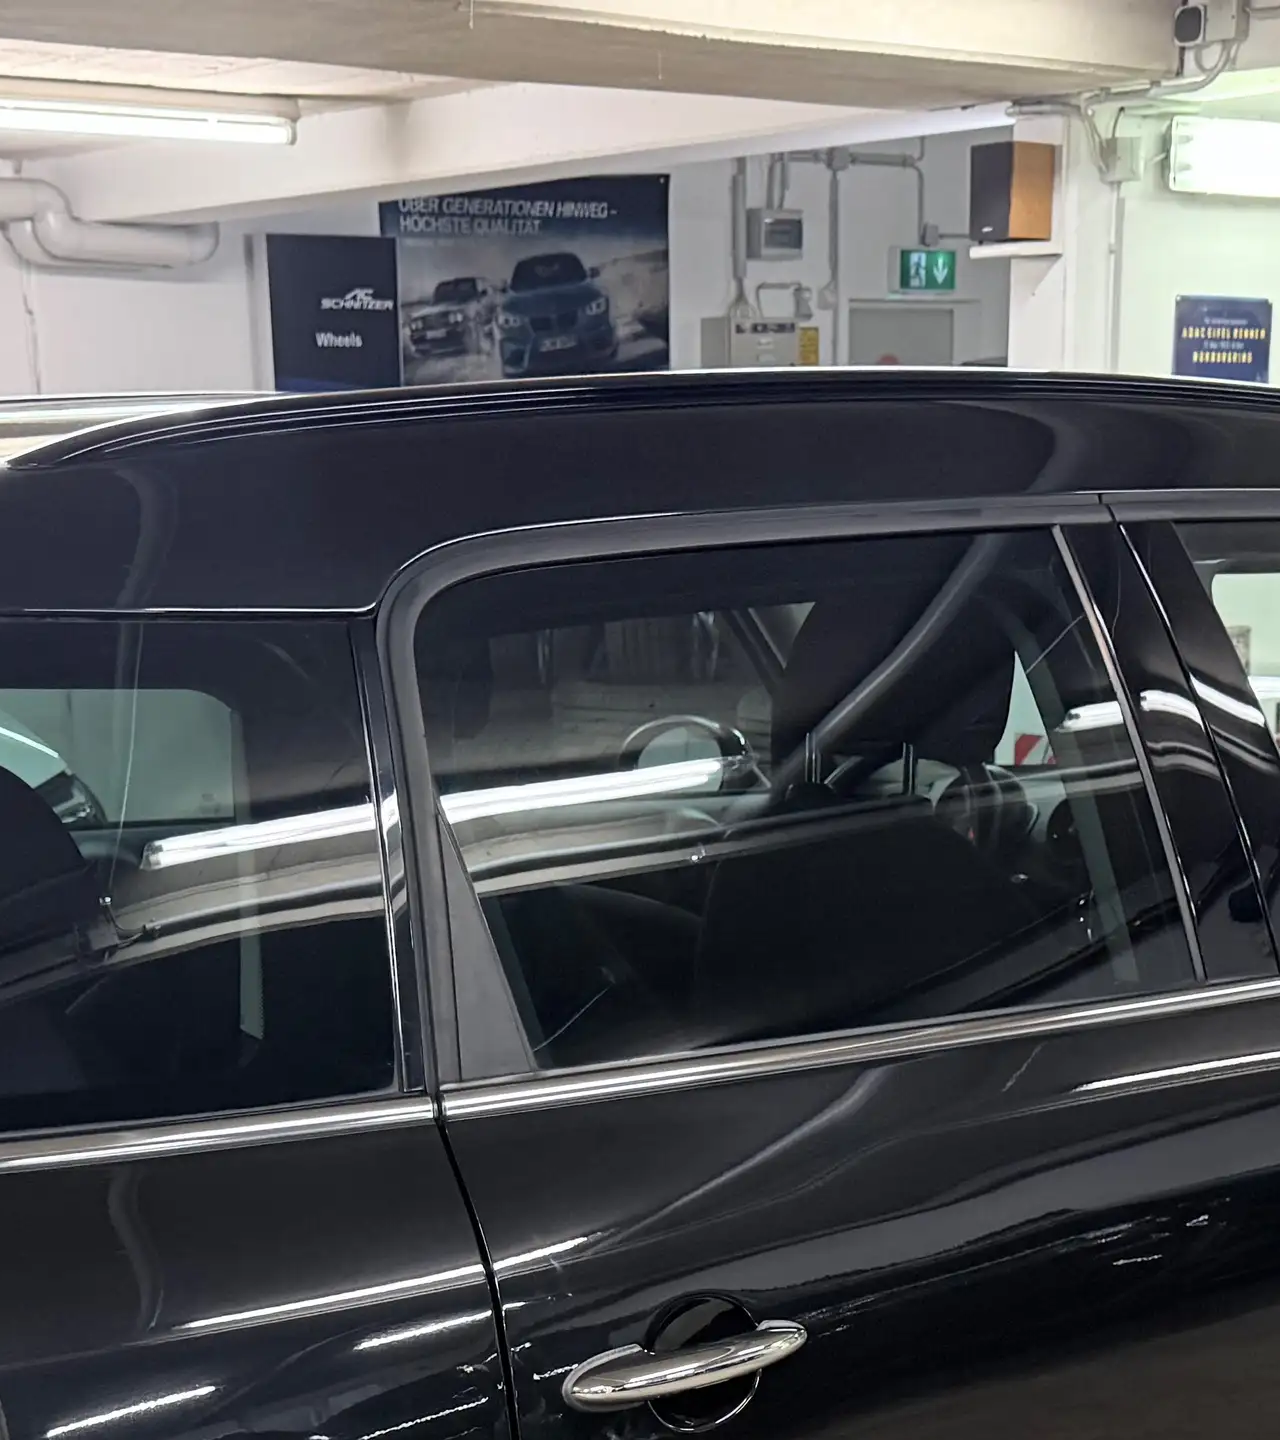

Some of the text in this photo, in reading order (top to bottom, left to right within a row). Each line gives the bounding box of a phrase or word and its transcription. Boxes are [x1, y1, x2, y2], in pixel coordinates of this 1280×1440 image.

[442, 198, 554, 217] GENERATIONEN
[556, 201, 608, 219] HINWEG
[399, 215, 542, 236] HÖCHSTE QUALITÄT
[315, 331, 363, 348] Wheels
